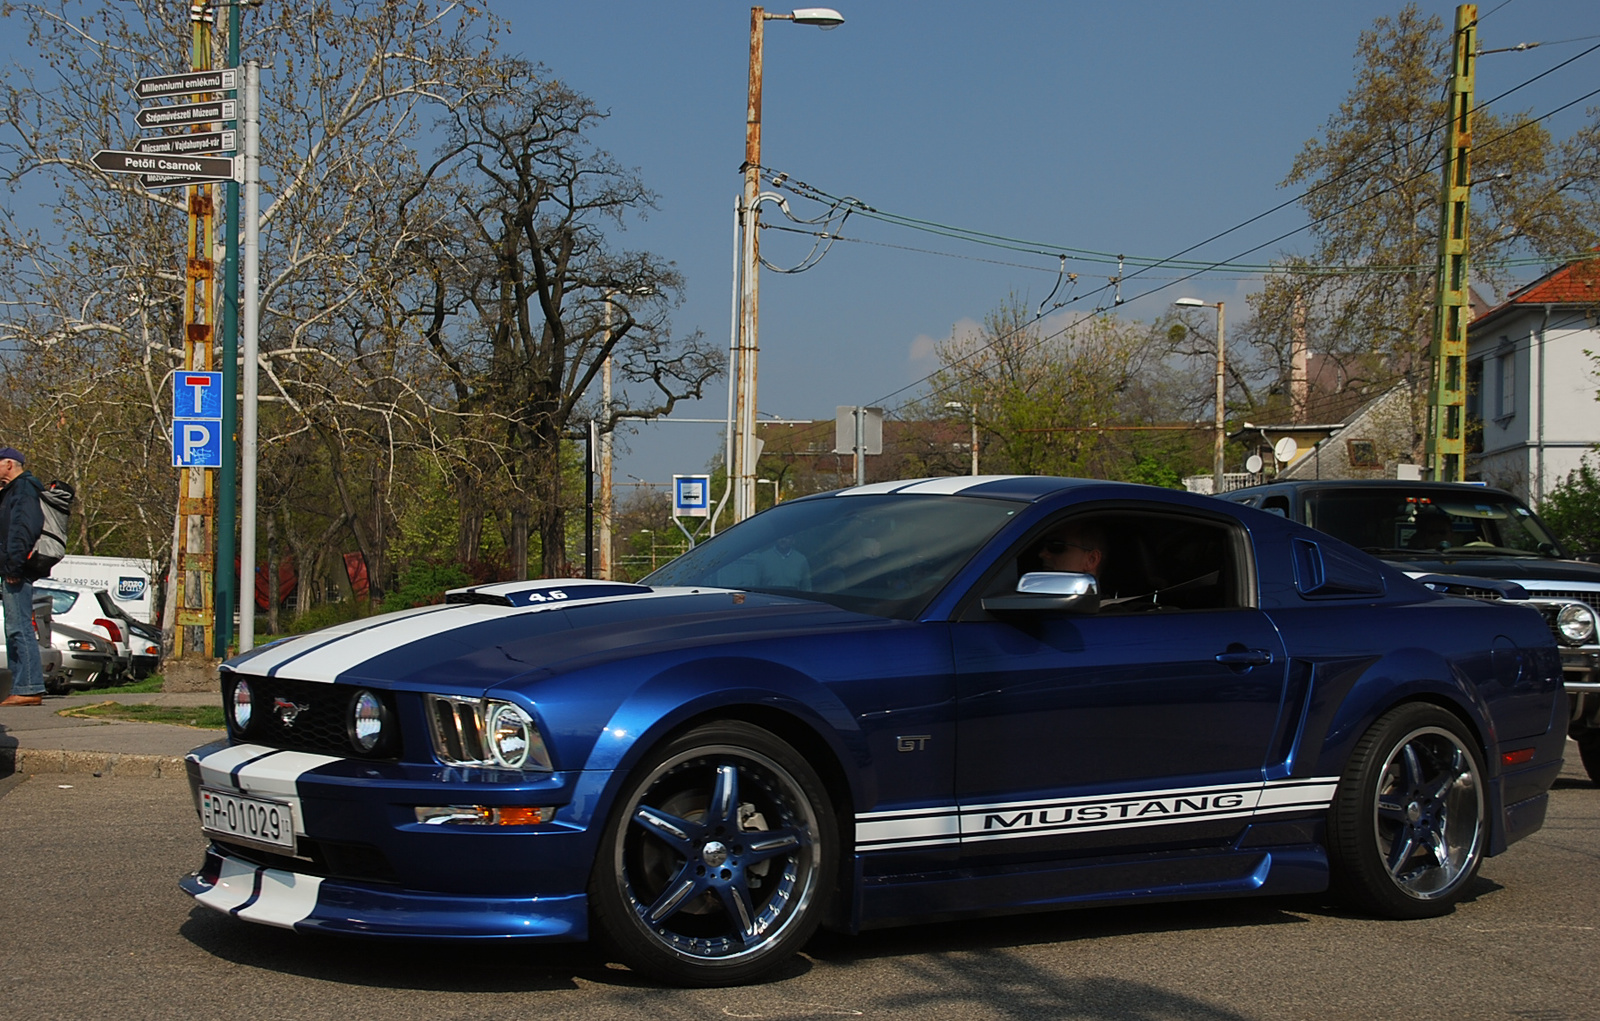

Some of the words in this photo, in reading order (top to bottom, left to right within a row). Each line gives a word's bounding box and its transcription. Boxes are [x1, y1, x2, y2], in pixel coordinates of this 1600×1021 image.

[142, 80, 184, 93] Millenniumi
[185, 76, 220, 89] emlékmű
[145, 109, 192, 123] Szépművészeti
[192, 108, 219, 118] Múzeum
[175, 137, 220, 151] Vajdahunyad-vár
[125, 157, 156, 168] Petőfi
[158, 160, 202, 171] Csarnok
[184, 425, 210, 462] P
[529, 590, 568, 602] 4.6
[897, 735, 932, 752] GT
[212, 796, 280, 840] P-01029
[983, 793, 1244, 830] MUSTANG
